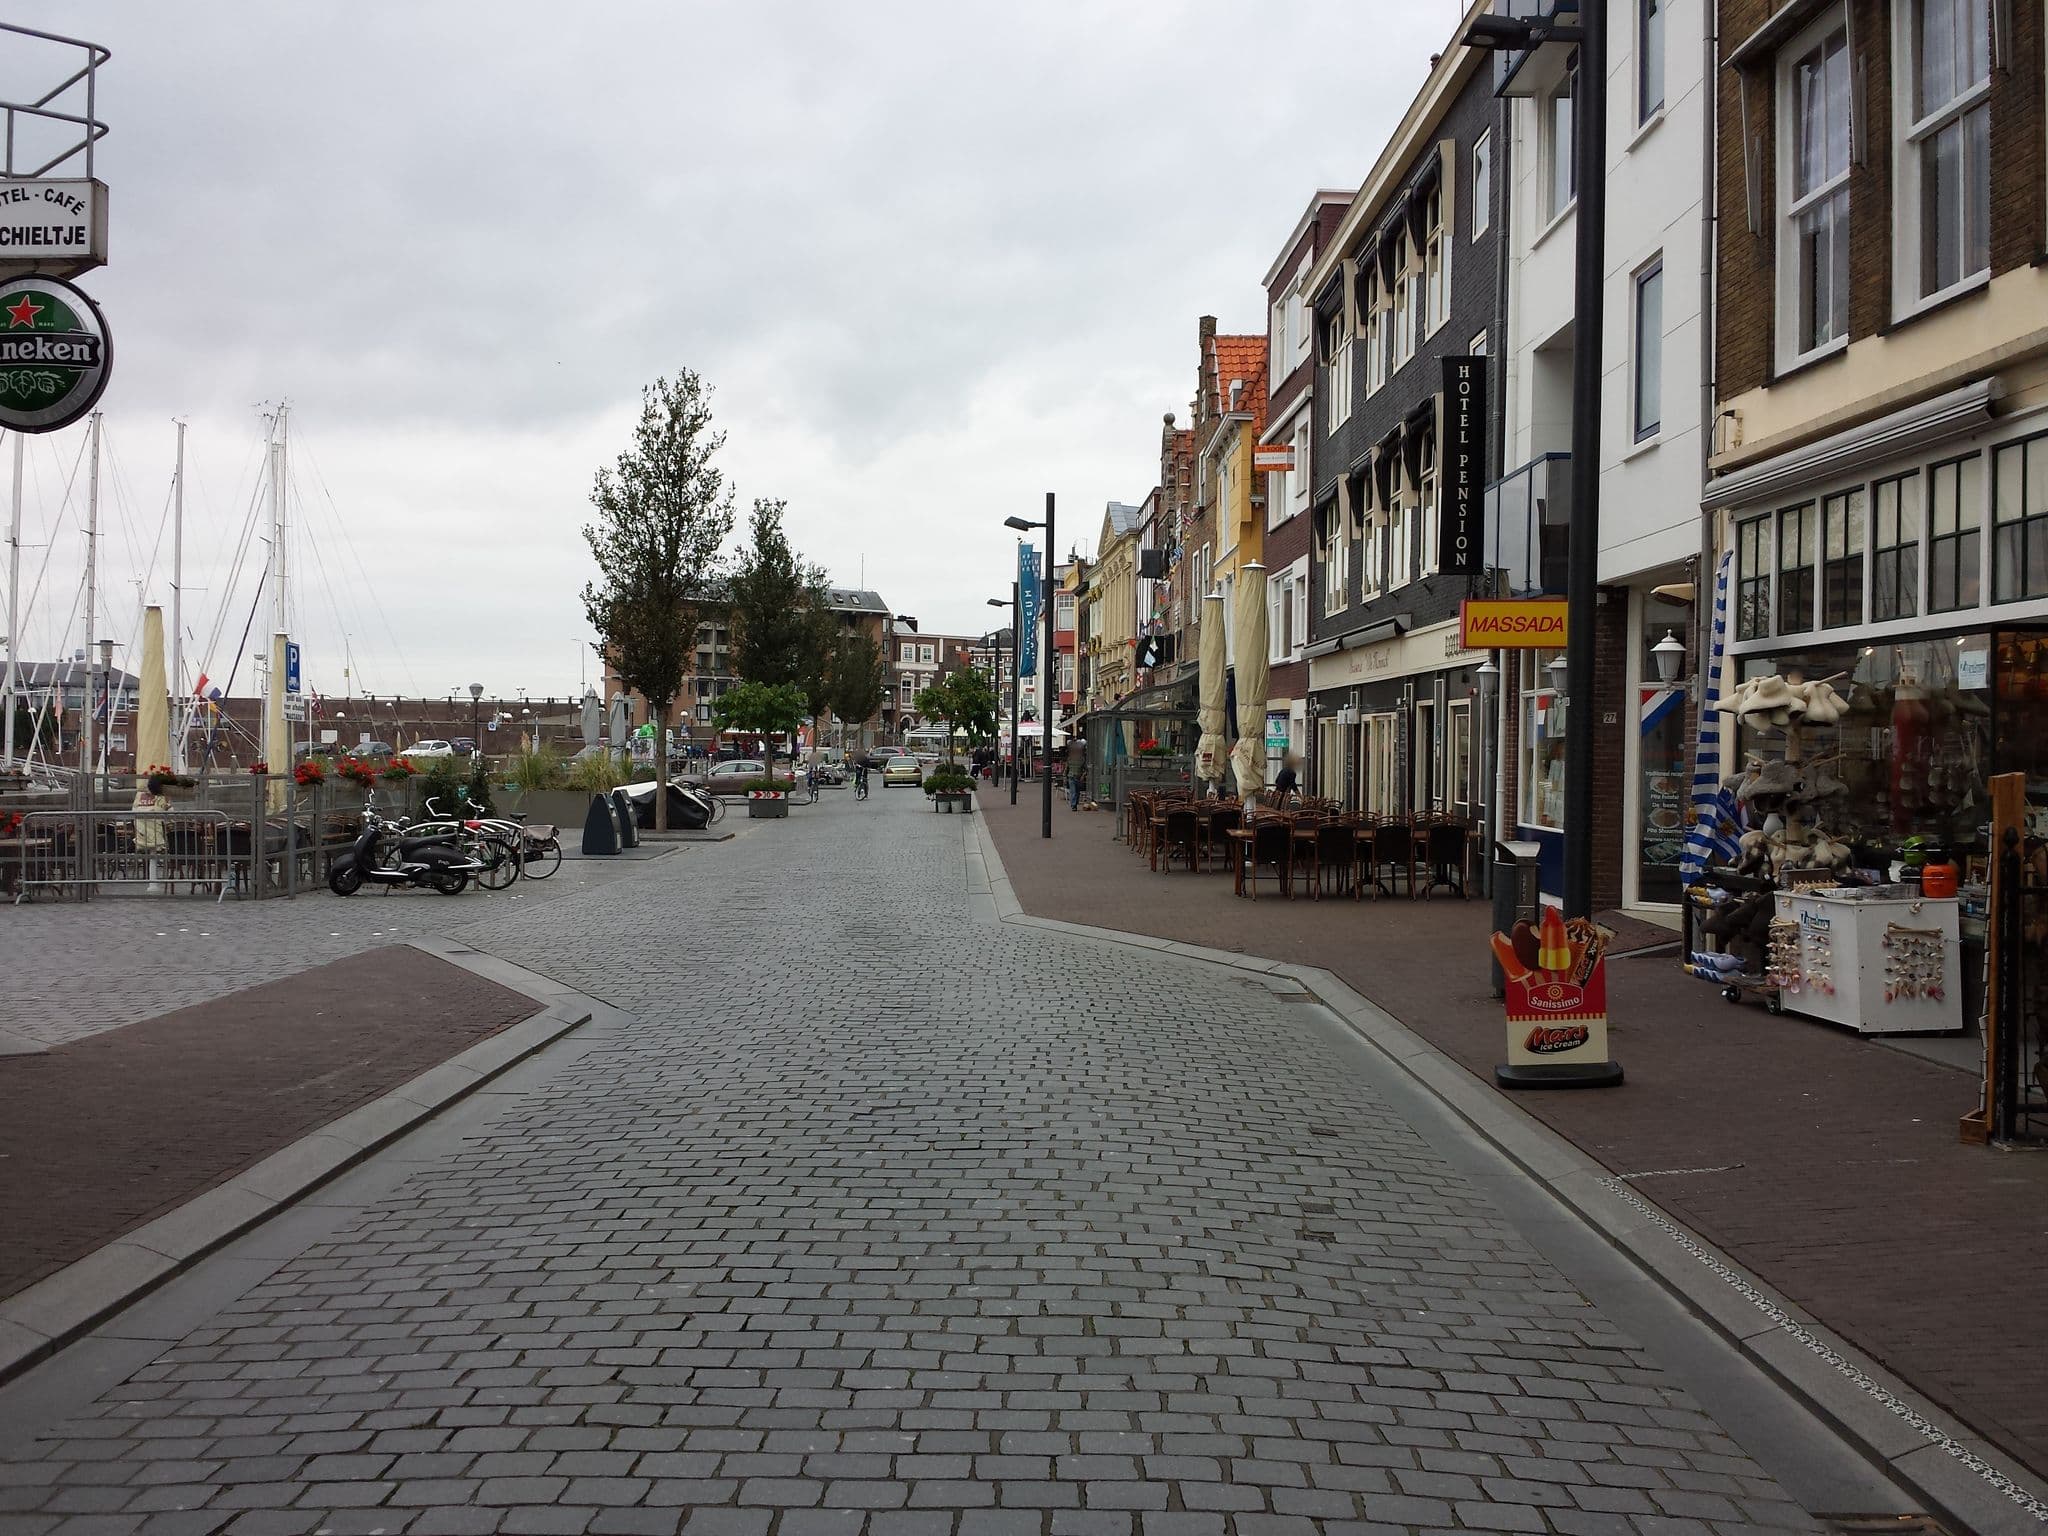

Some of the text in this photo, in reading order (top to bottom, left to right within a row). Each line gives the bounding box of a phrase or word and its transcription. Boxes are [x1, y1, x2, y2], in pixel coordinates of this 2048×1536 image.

[0, 187, 30, 207] TEL
[44, 187, 86, 216] CAFÉ
[0, 225, 86, 246] CHIELTJE
[0, 337, 92, 361] neken
[1455, 365, 1471, 566] HOTEL PENSION
[1469, 615, 1564, 633] MASSADA
[290, 647, 298, 671] P
[1605, 713, 1615, 722] 27
[1531, 996, 1580, 1009] Sanissimo
[1524, 1024, 1588, 1049] Mars
[1554, 1039, 1581, 1050] Cream
